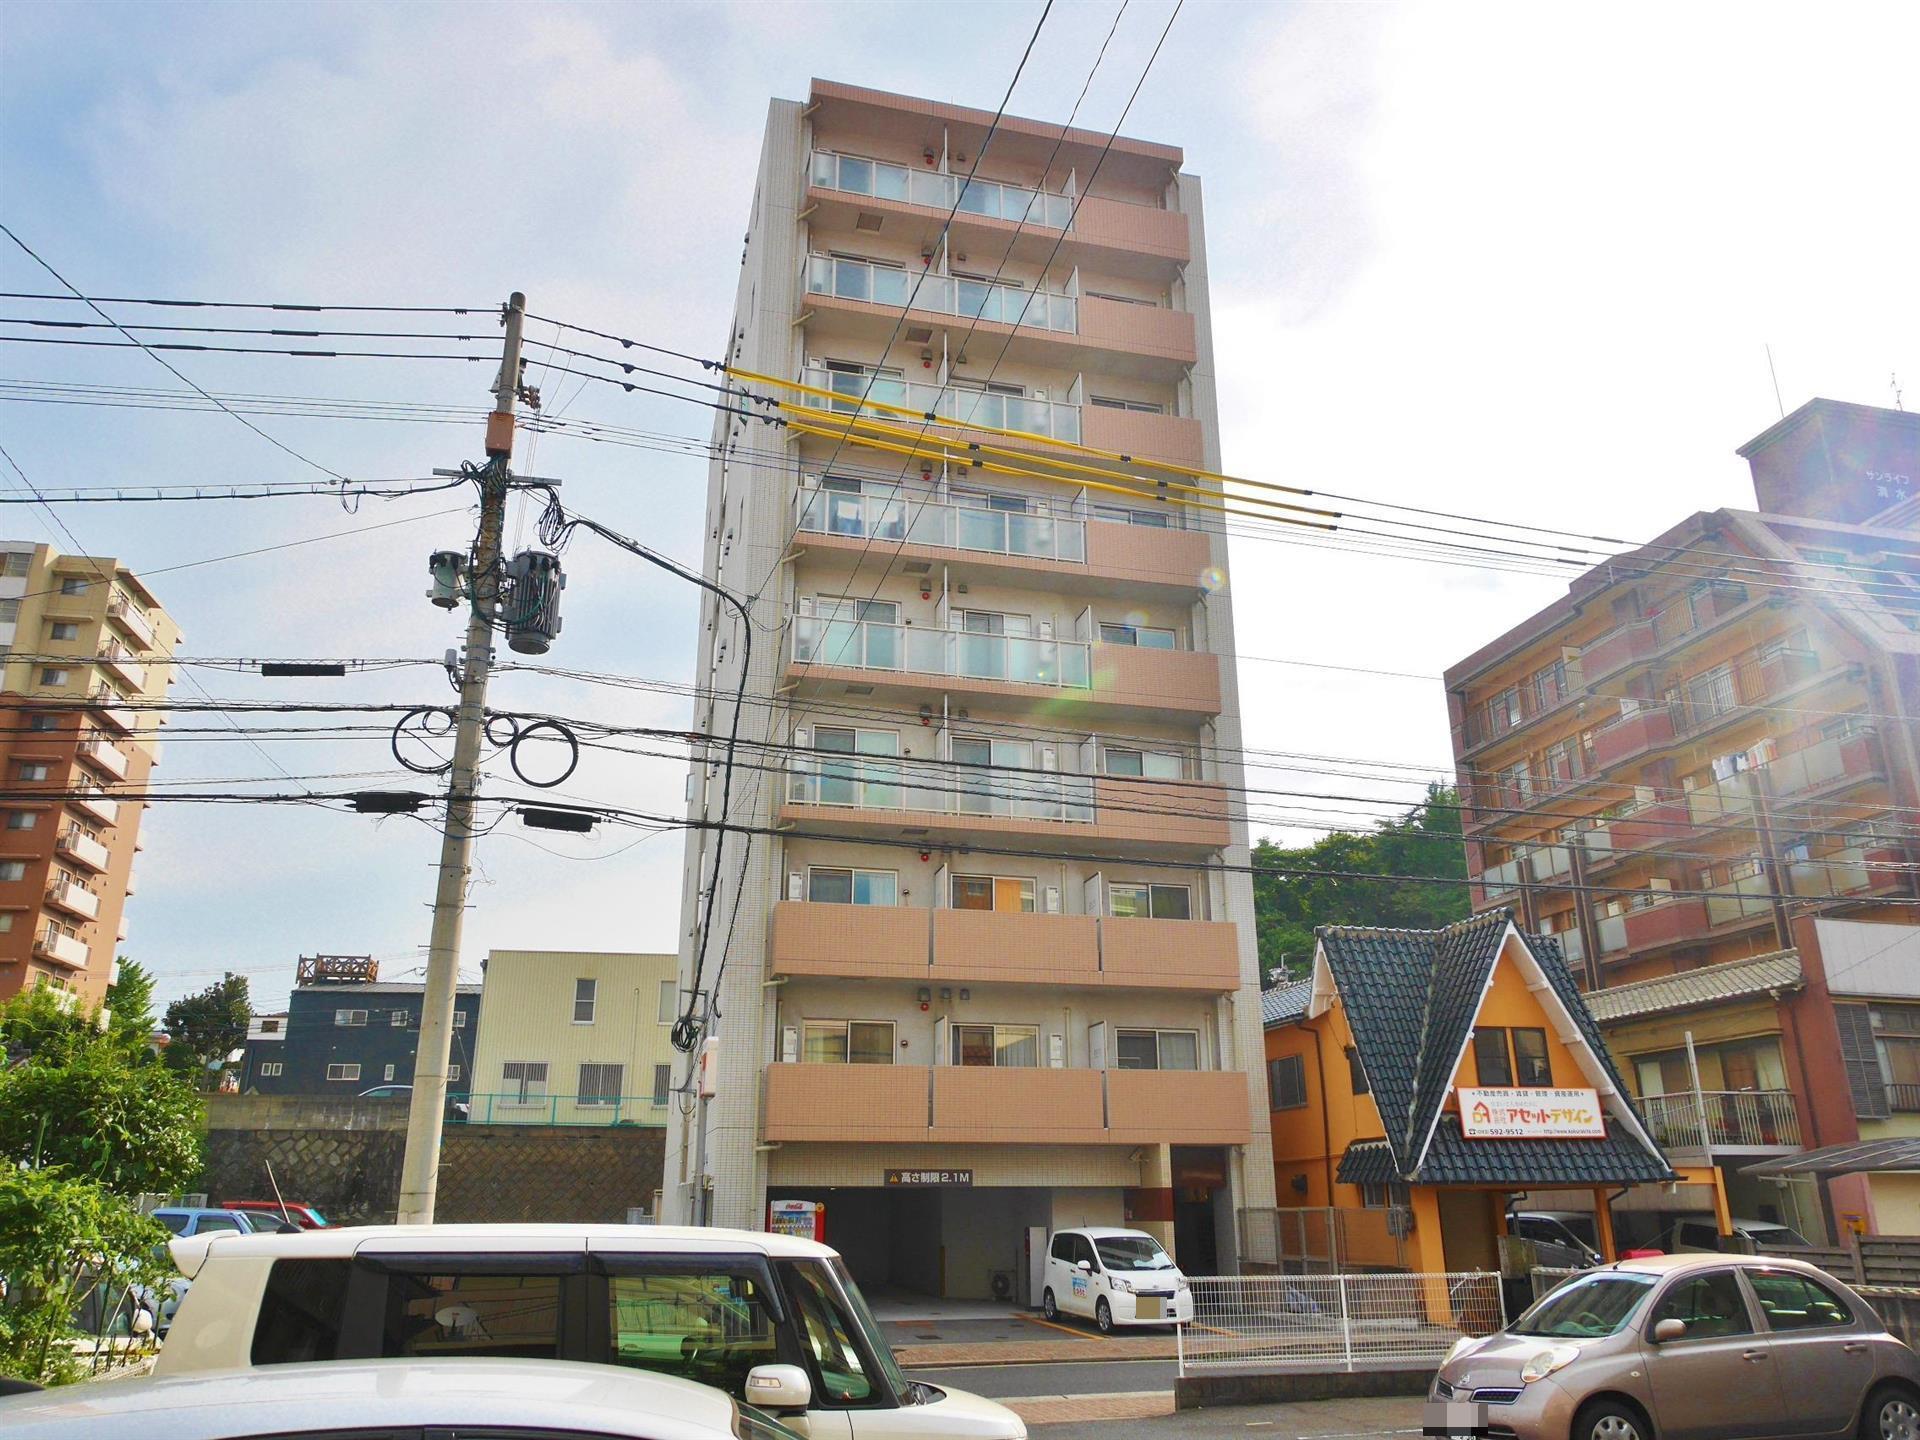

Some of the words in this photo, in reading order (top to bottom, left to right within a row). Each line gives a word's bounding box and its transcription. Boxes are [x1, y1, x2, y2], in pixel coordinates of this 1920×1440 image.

[1506, 1108, 1594, 1124] アセットデザイン
